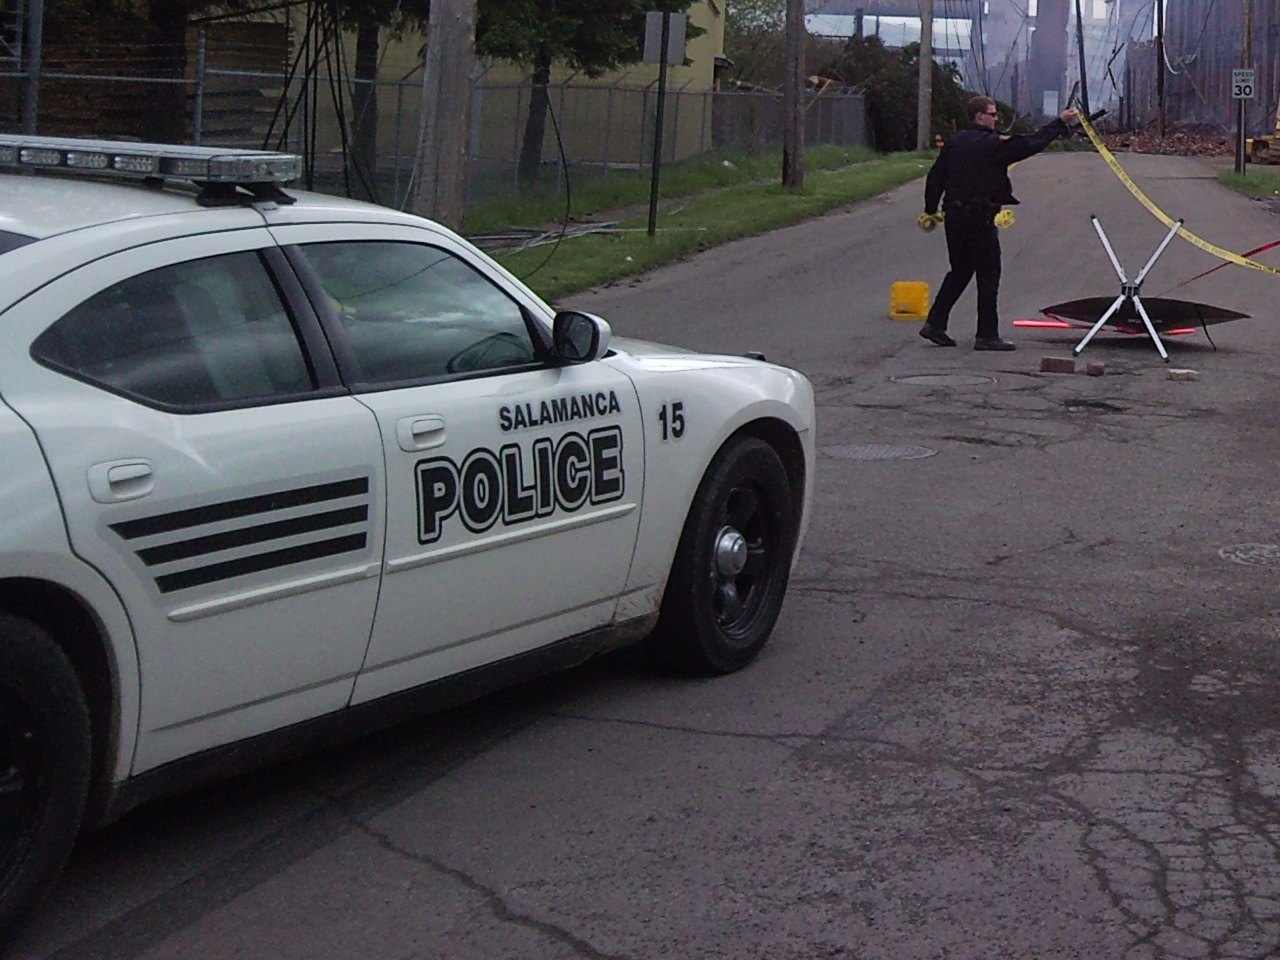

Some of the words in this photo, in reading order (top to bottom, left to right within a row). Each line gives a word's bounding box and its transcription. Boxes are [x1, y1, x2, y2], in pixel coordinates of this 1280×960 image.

[1234, 84, 1253, 97] 30
[499, 390, 621, 432] SALAMANCA
[658, 401, 686, 441] 15
[414, 424, 626, 546] POLICE
